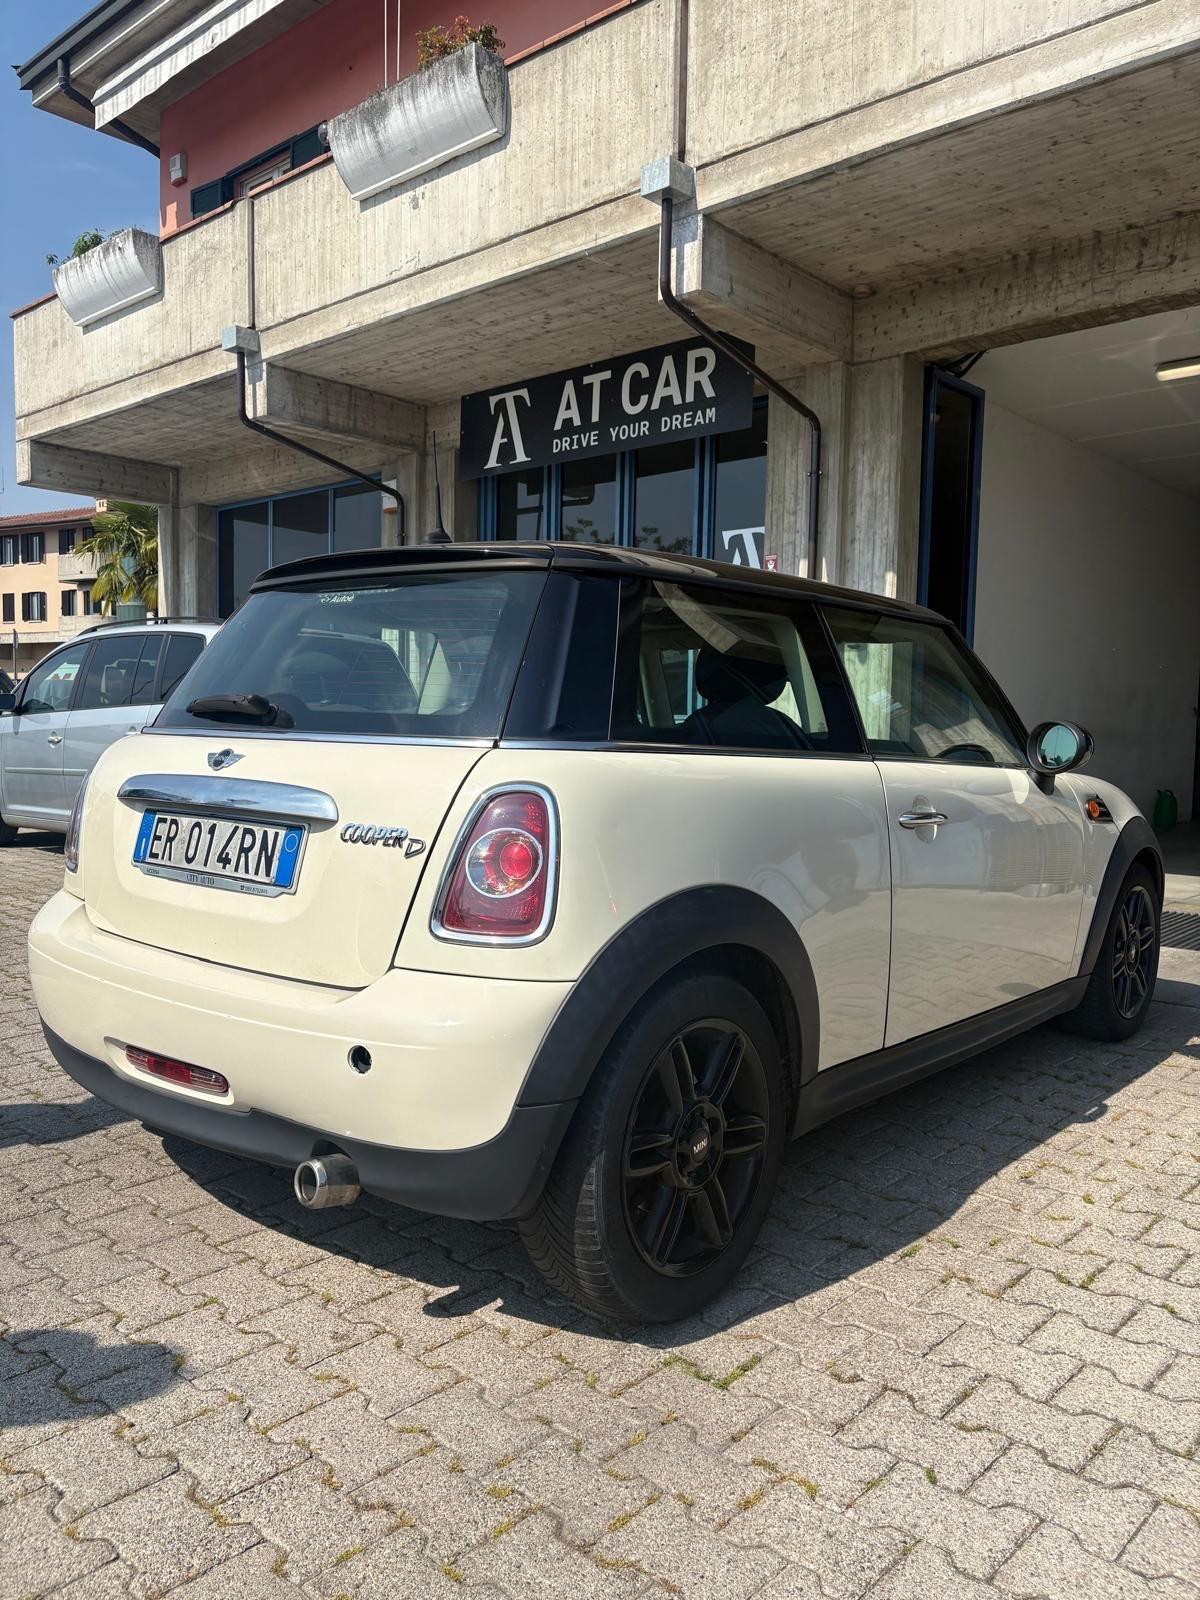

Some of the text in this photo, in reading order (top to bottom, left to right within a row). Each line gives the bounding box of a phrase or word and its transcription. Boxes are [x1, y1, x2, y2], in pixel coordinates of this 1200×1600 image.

[554, 347, 716, 431] AT CAR
[553, 407, 716, 453] DRIVE YOUR DREAM
[148, 816, 180, 862] ER
[184, 820, 280, 878] 014RN
[340, 822, 427, 859] COOPER D
[186, 873, 198, 883] CITY
[693, 1137, 708, 1154] MINI
